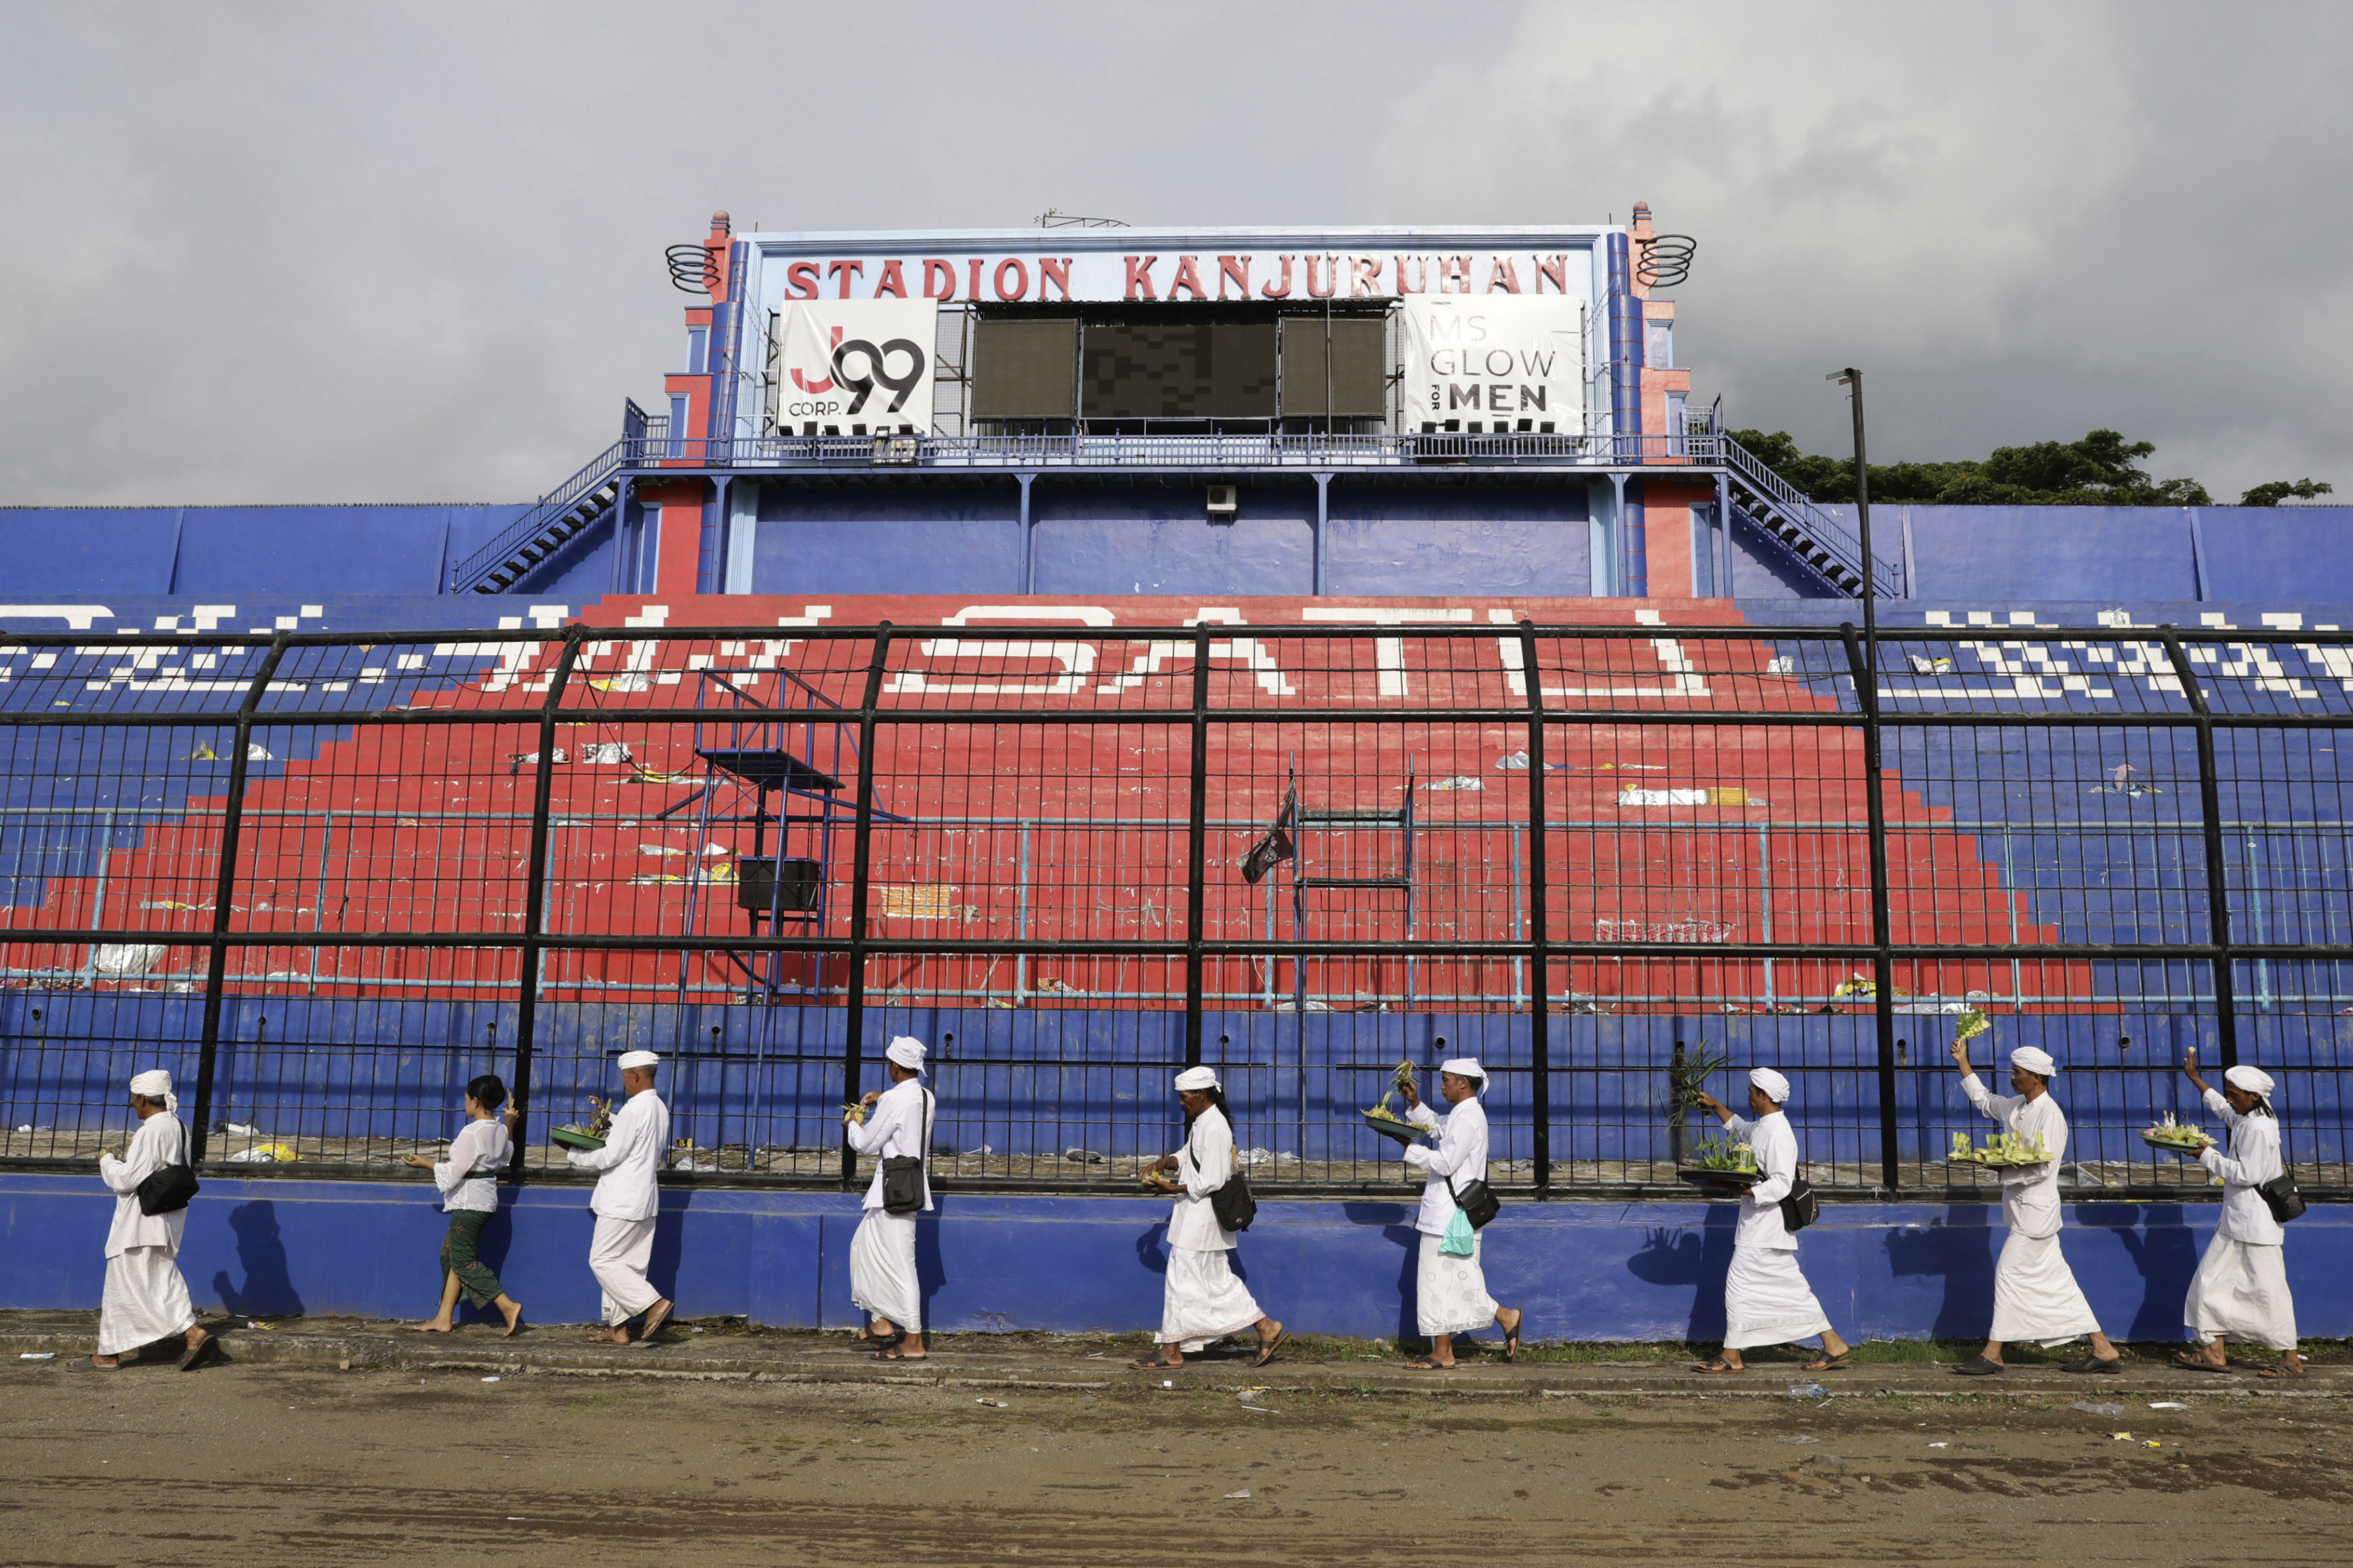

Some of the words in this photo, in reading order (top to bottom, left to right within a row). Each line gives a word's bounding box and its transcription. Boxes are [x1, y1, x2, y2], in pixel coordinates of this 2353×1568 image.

[785, 257, 1073, 301] STADION
[1123, 253, 1568, 301] KANJURUHAN
[1430, 315, 1487, 341] MS
[791, 326, 926, 415] J99
[1431, 349, 1556, 377] GLOW
[1431, 384, 1440, 410] FOR
[1449, 383, 1546, 412] MEN
[884, 605, 1713, 697] SATU
